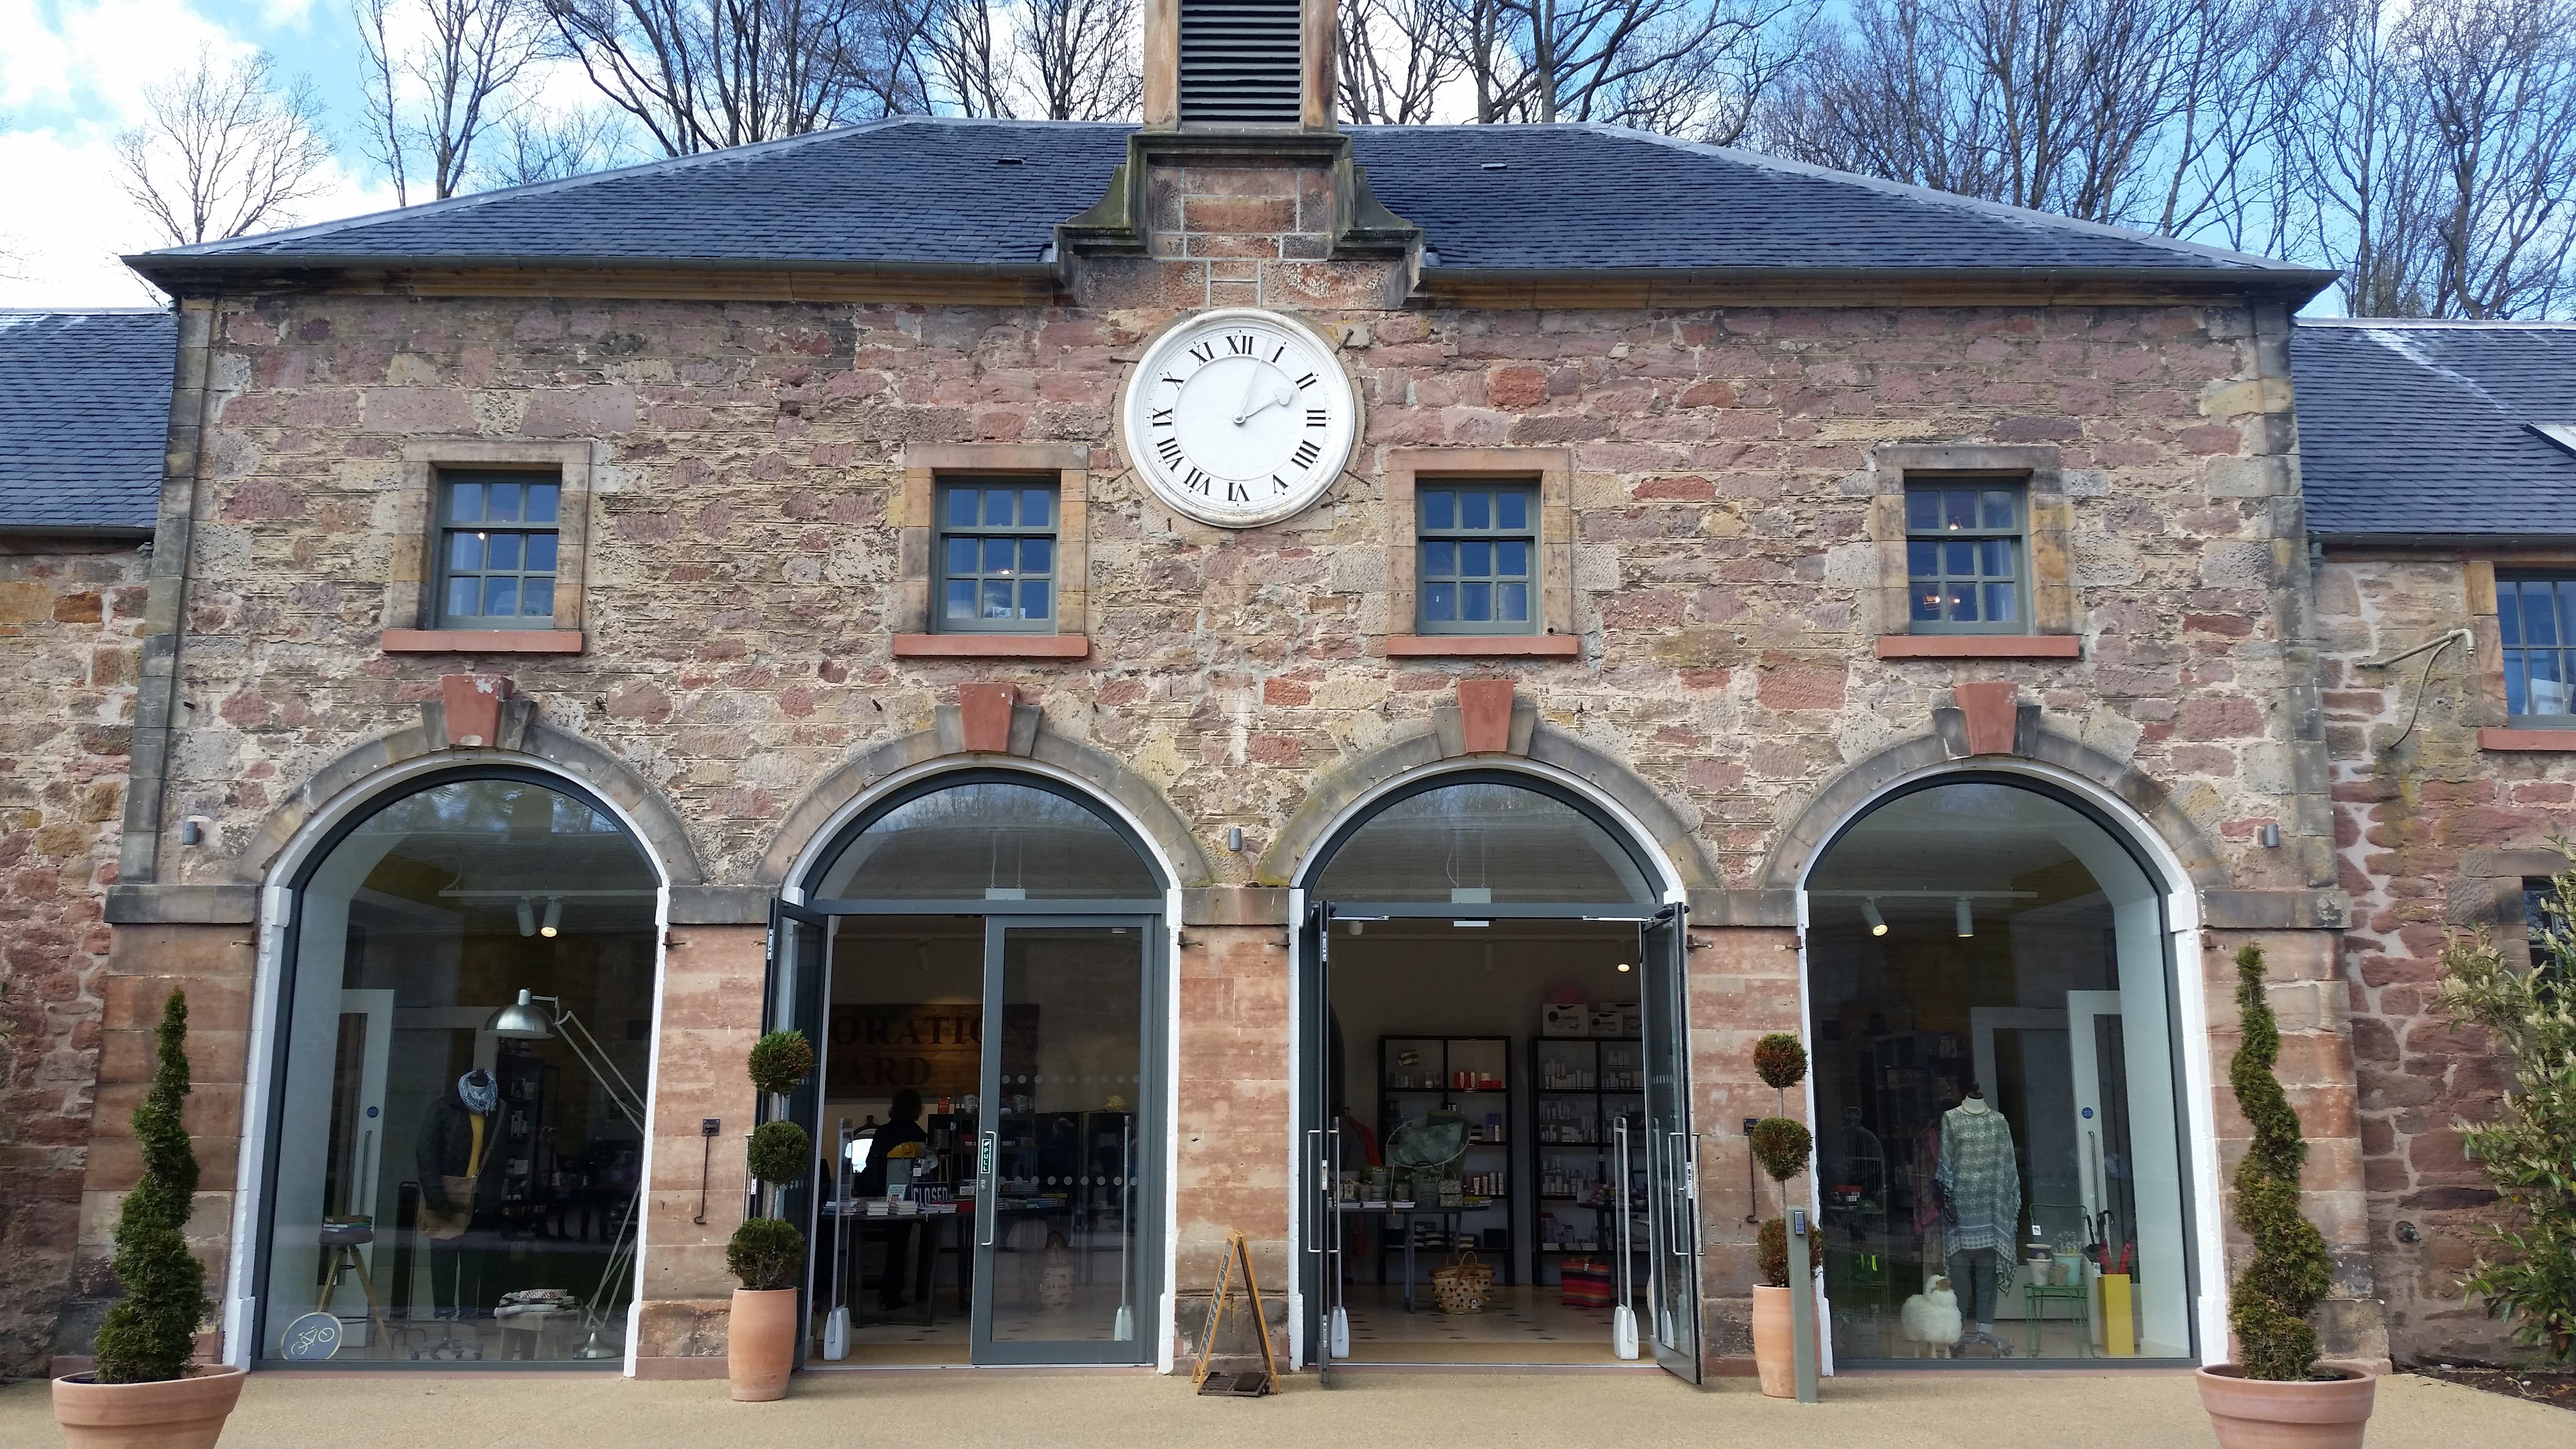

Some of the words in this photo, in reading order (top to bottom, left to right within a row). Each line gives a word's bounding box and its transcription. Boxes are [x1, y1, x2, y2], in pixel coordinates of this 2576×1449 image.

[1189, 341, 1216, 366] XI
[1225, 335, 1254, 355] XII
[1271, 346, 1285, 363] I
[1162, 371, 1185, 390] X
[1295, 372, 1318, 391] II
[1152, 407, 1173, 428] IX
[1306, 408, 1326, 428] III
[1156, 436, 1184, 472] VIII
[1290, 439, 1321, 470] IIII
[1183, 467, 1210, 496] VII
[1272, 474, 1289, 495] V
[1227, 482, 1250, 502] VI
[913, 1187, 948, 1207] CLOSED
